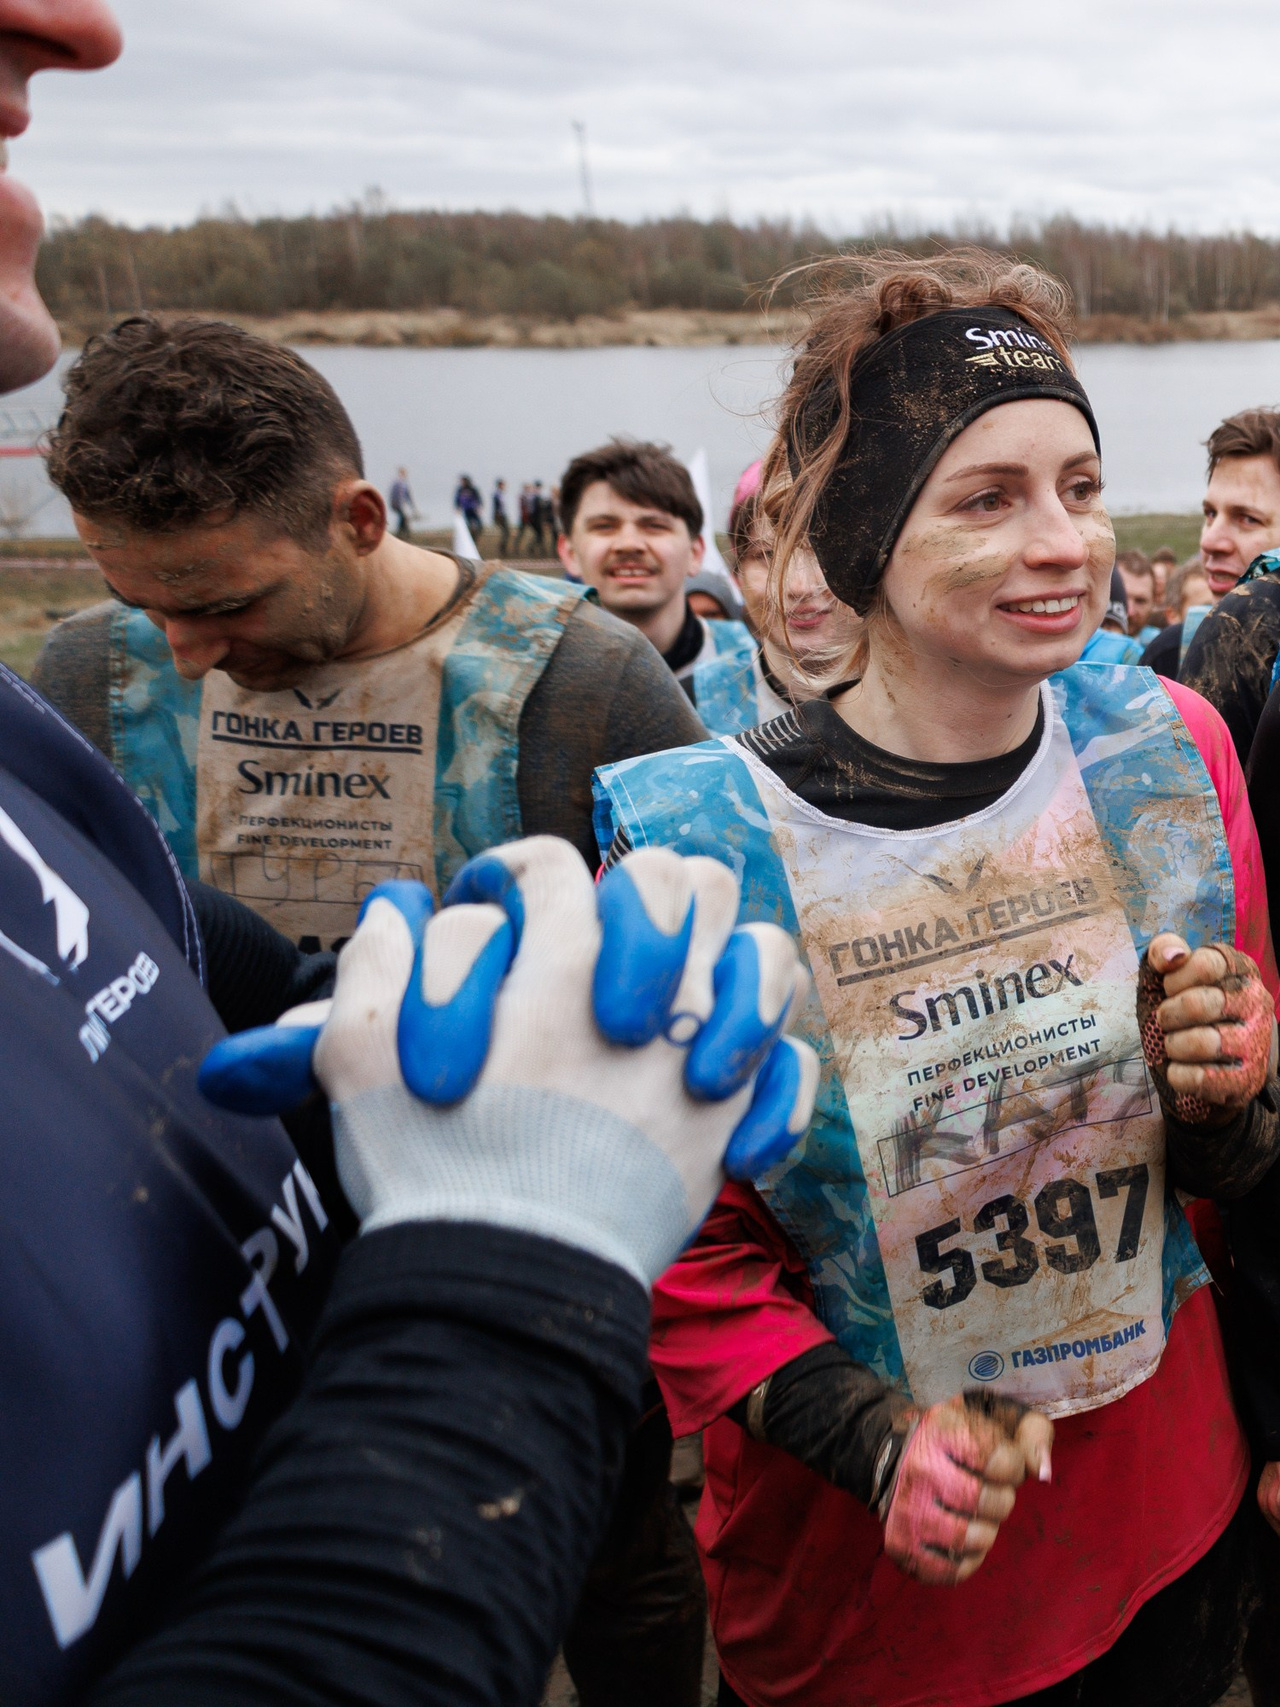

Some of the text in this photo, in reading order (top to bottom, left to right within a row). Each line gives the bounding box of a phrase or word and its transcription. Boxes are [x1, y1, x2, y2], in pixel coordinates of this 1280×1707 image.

[999, 346, 1063, 373] team
[212, 710, 423, 746] ГОНКА ГЕРОЕВ
[237, 760, 392, 800] Sminex
[236, 833, 393, 851] FINE DEVELOPMENT
[238, 815, 393, 833] ПЕРФЕКЦИОНИСТЫ
[828, 876, 1102, 975] ГОНКА ГЕРОЕВ
[889, 953, 1084, 1041] Sminex
[906, 1013, 1097, 1087] ПЕРФЕКЦИОНИСТЫ
[912, 1038, 1102, 1113] FINE DEVELOPMENT
[914, 1162, 1150, 1311] 5397
[1010, 1319, 1147, 1369] ГАЗПРОМБАНК
